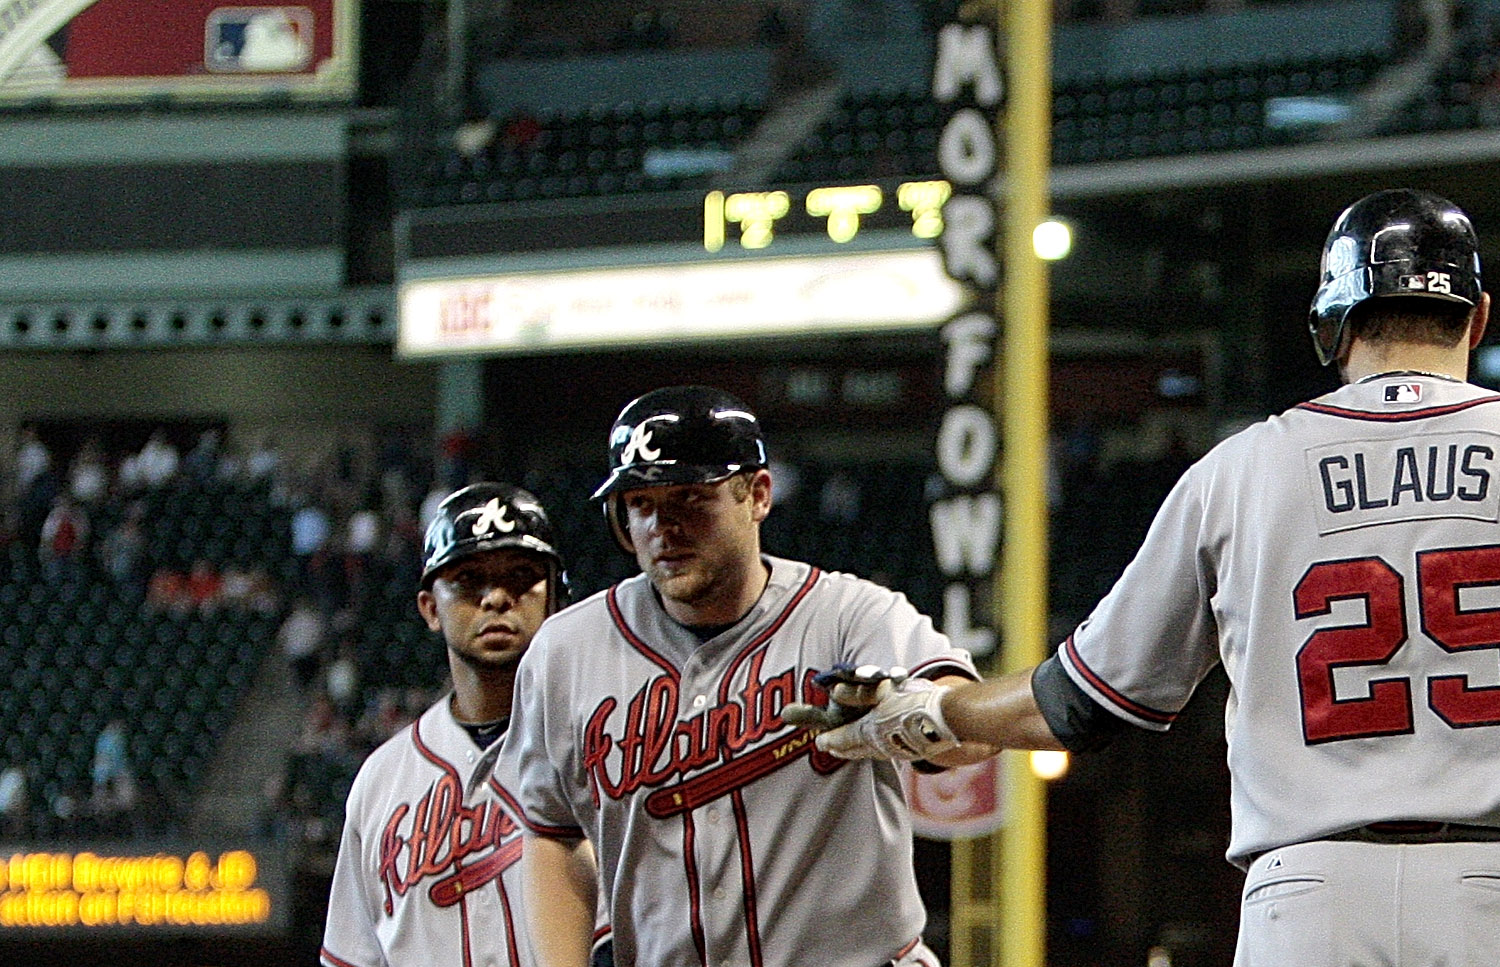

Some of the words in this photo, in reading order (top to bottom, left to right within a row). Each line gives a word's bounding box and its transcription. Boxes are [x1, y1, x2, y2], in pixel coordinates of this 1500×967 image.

[1426, 271, 1451, 294] 25
[1319, 444, 1494, 513] GLAUS
[584, 640, 796, 808] Atlanta
